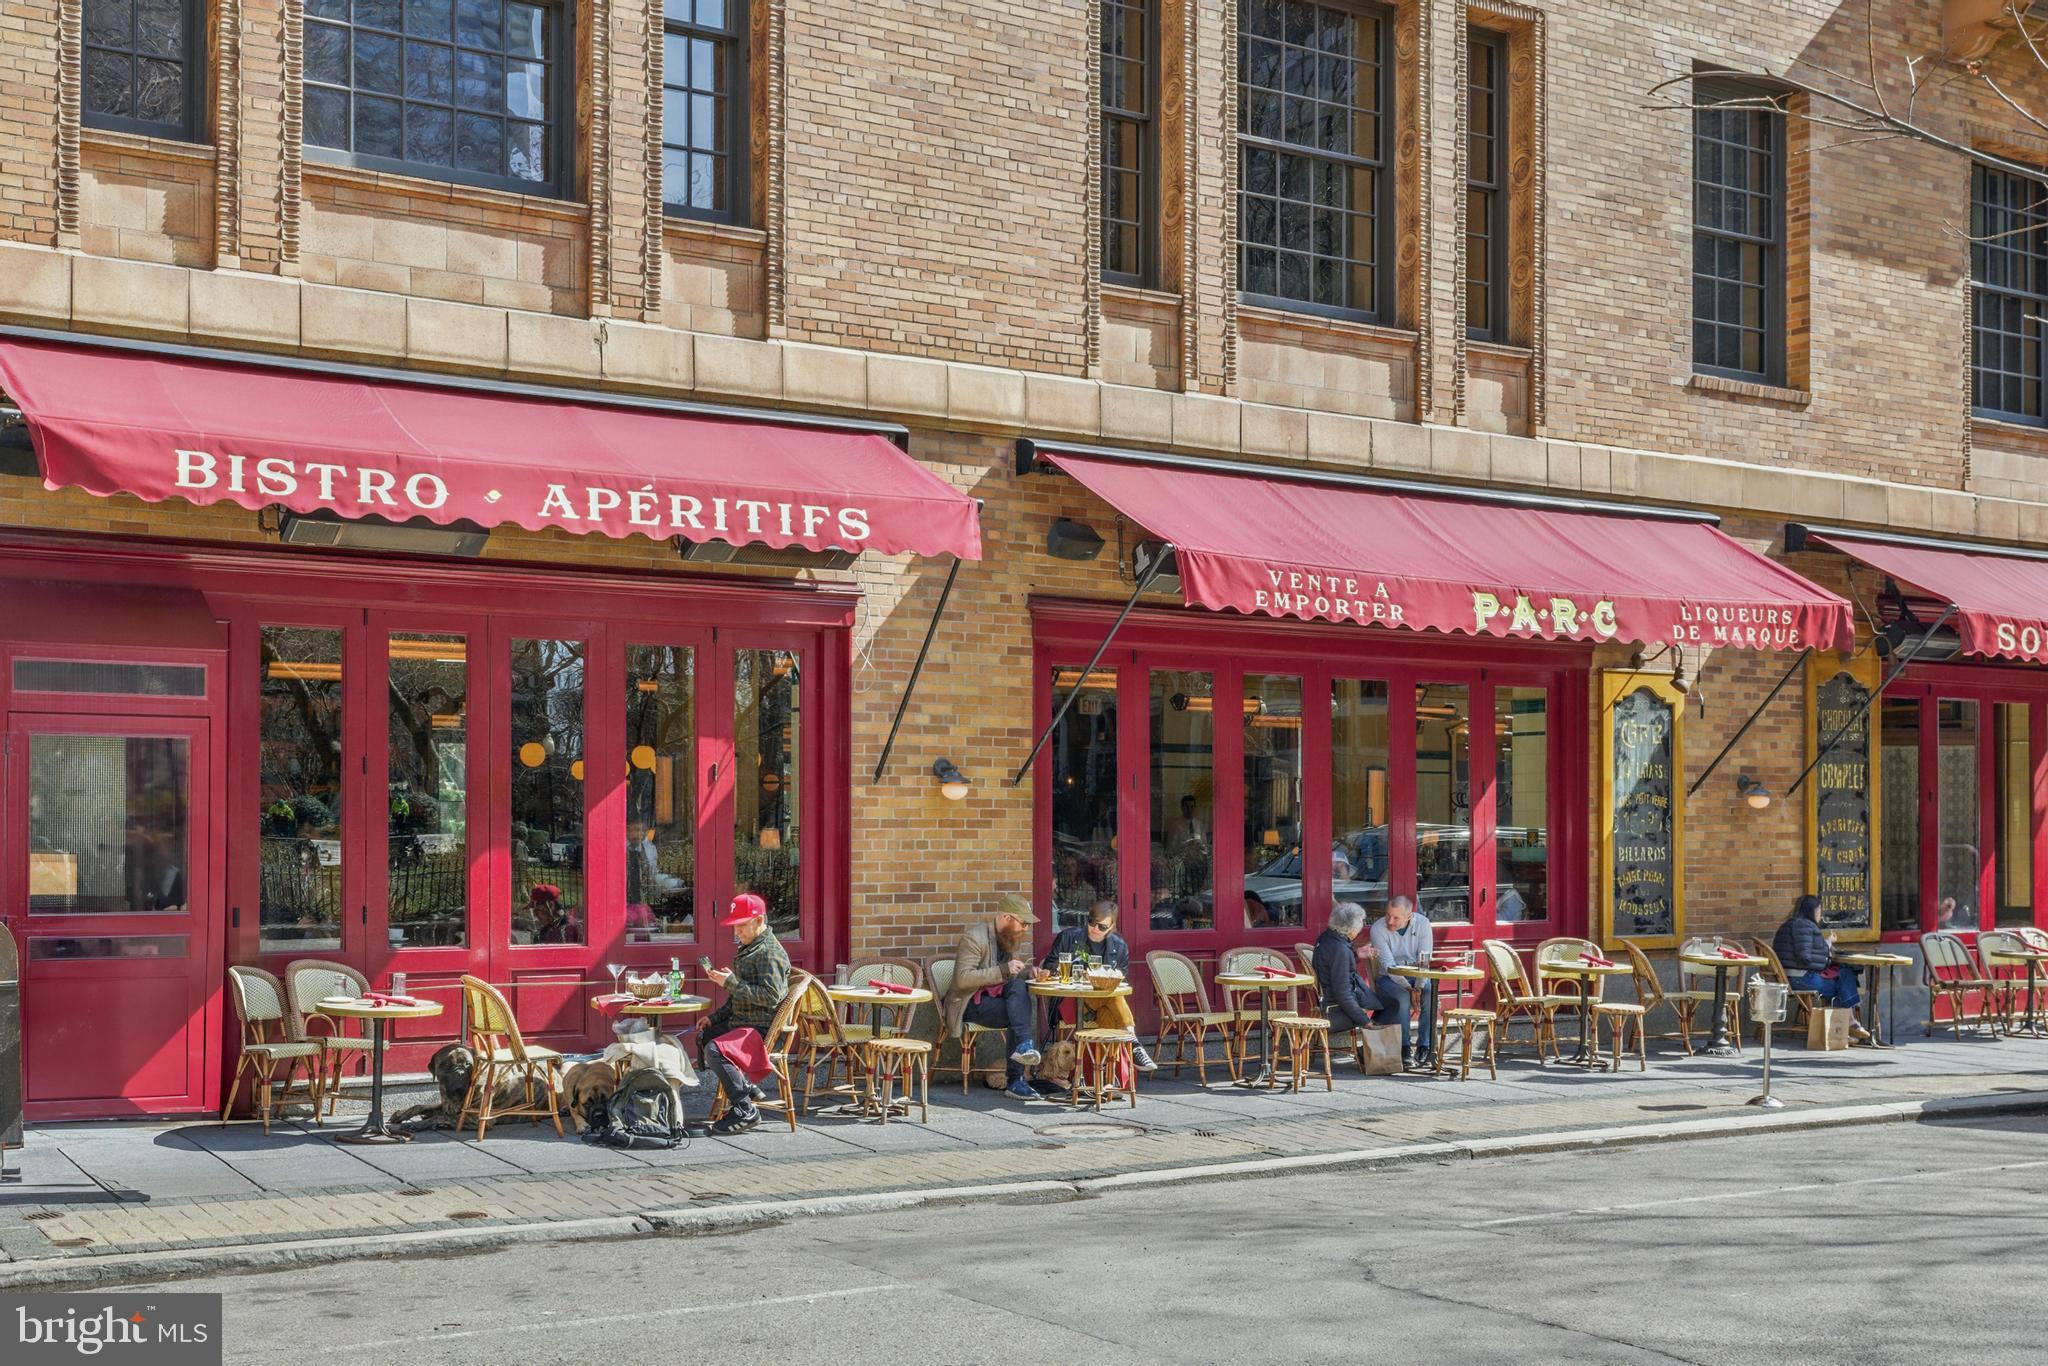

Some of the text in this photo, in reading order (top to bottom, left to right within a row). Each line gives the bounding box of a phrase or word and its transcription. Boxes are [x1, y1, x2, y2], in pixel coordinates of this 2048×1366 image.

[174, 449, 870, 541] BISTRO APÉRITIFS
[1268, 569, 1389, 598] VENTE A
[1255, 590, 1403, 621] EMPORTER
[1681, 605, 1793, 625] LIQUEURS
[1673, 625, 1799, 644] DE MARQUE
[1997, 623, 2048, 654] SO
[1821, 763, 1865, 789] COMPLET
[1618, 846, 1666, 862] BILLARDS
